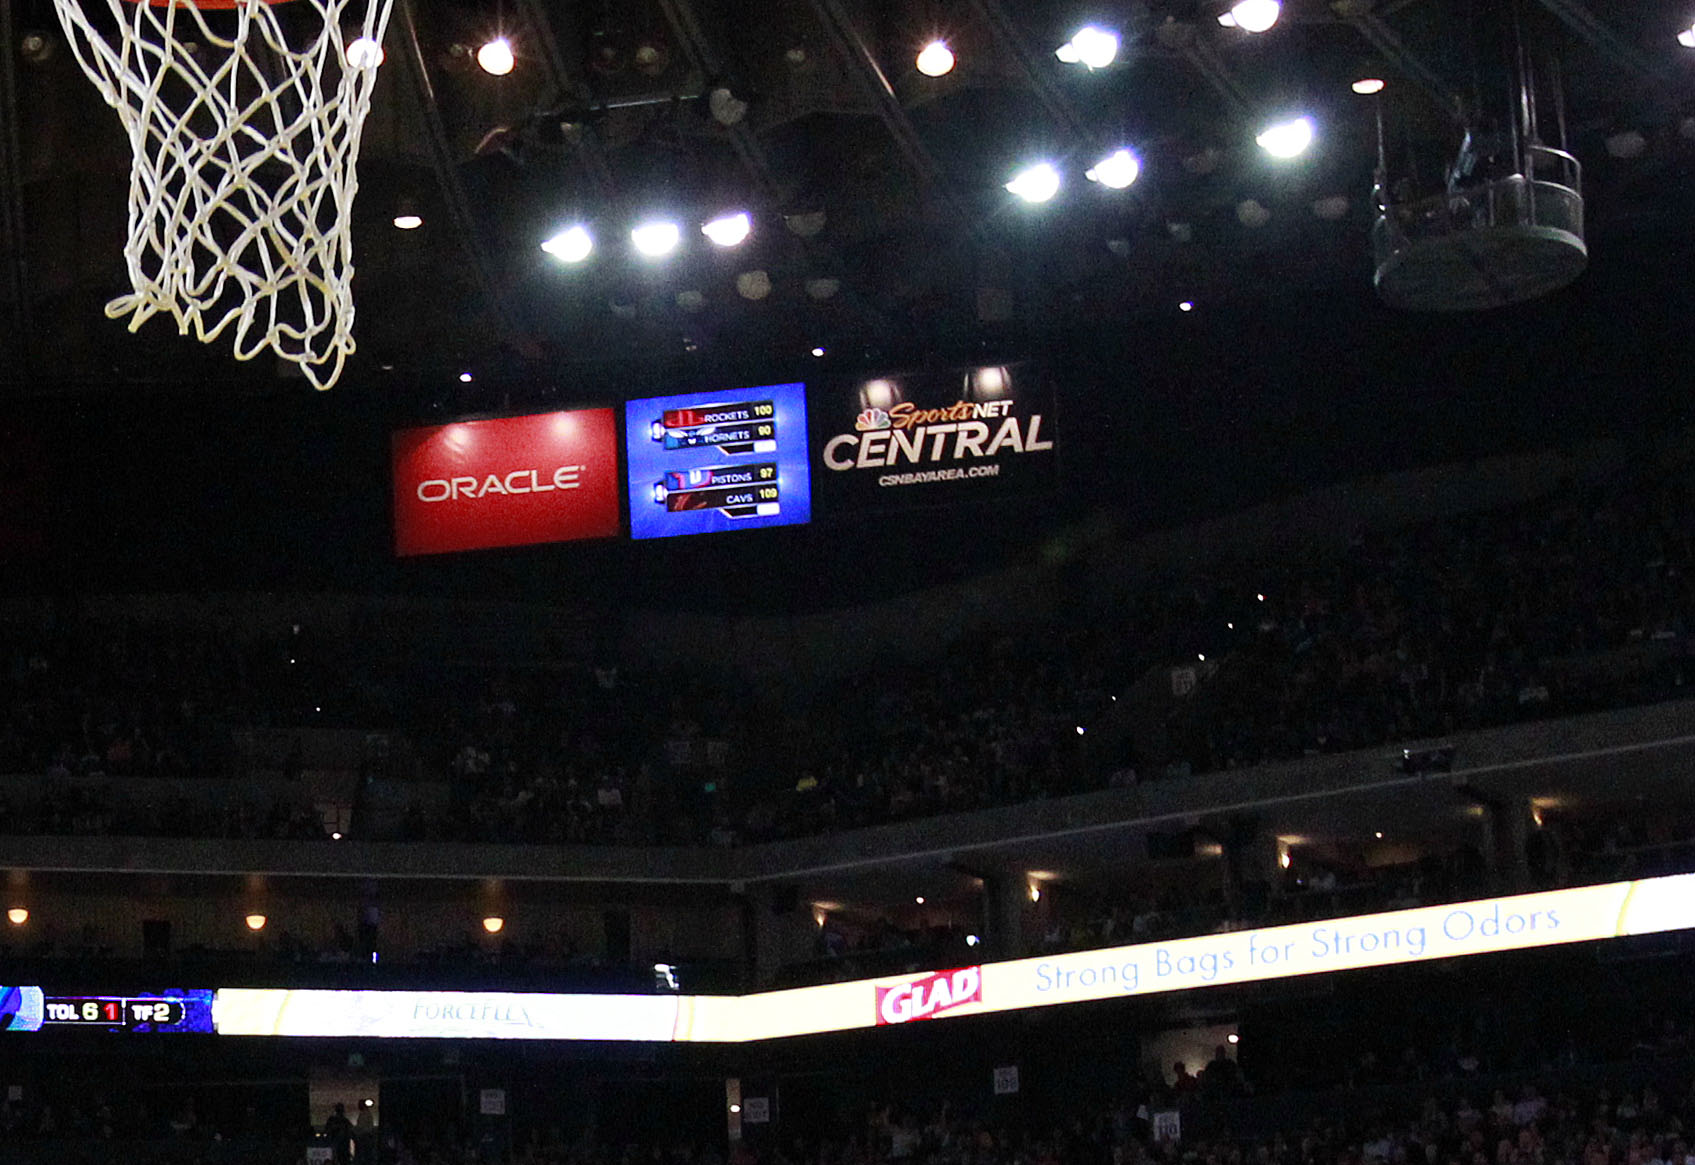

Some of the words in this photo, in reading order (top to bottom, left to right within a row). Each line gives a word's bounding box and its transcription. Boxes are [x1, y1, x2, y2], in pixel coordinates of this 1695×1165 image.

[704, 410, 750, 423] ROCKETS
[754, 405, 773, 416] 100
[704, 430, 750, 443] HORNETS
[823, 415, 1054, 471] CENTRAL
[416, 466, 581, 503] ORACLE
[712, 472, 753, 484] PISTONS
[879, 464, 1000, 487] CSNBAYAREA.COM
[726, 493, 754, 504] CAVS
[1036, 962, 1139, 991] Strong
[1156, 948, 1234, 981] Bags
[1249, 934, 1295, 965] for
[1312, 927, 1426, 957] Strong
[1443, 903, 1560, 940] Odors
[881, 966, 979, 1024] GLAD
[46, 1004, 80, 1021] TOL
[82, 1002, 99, 1021] 6
[104, 1002, 119, 1021] 1
